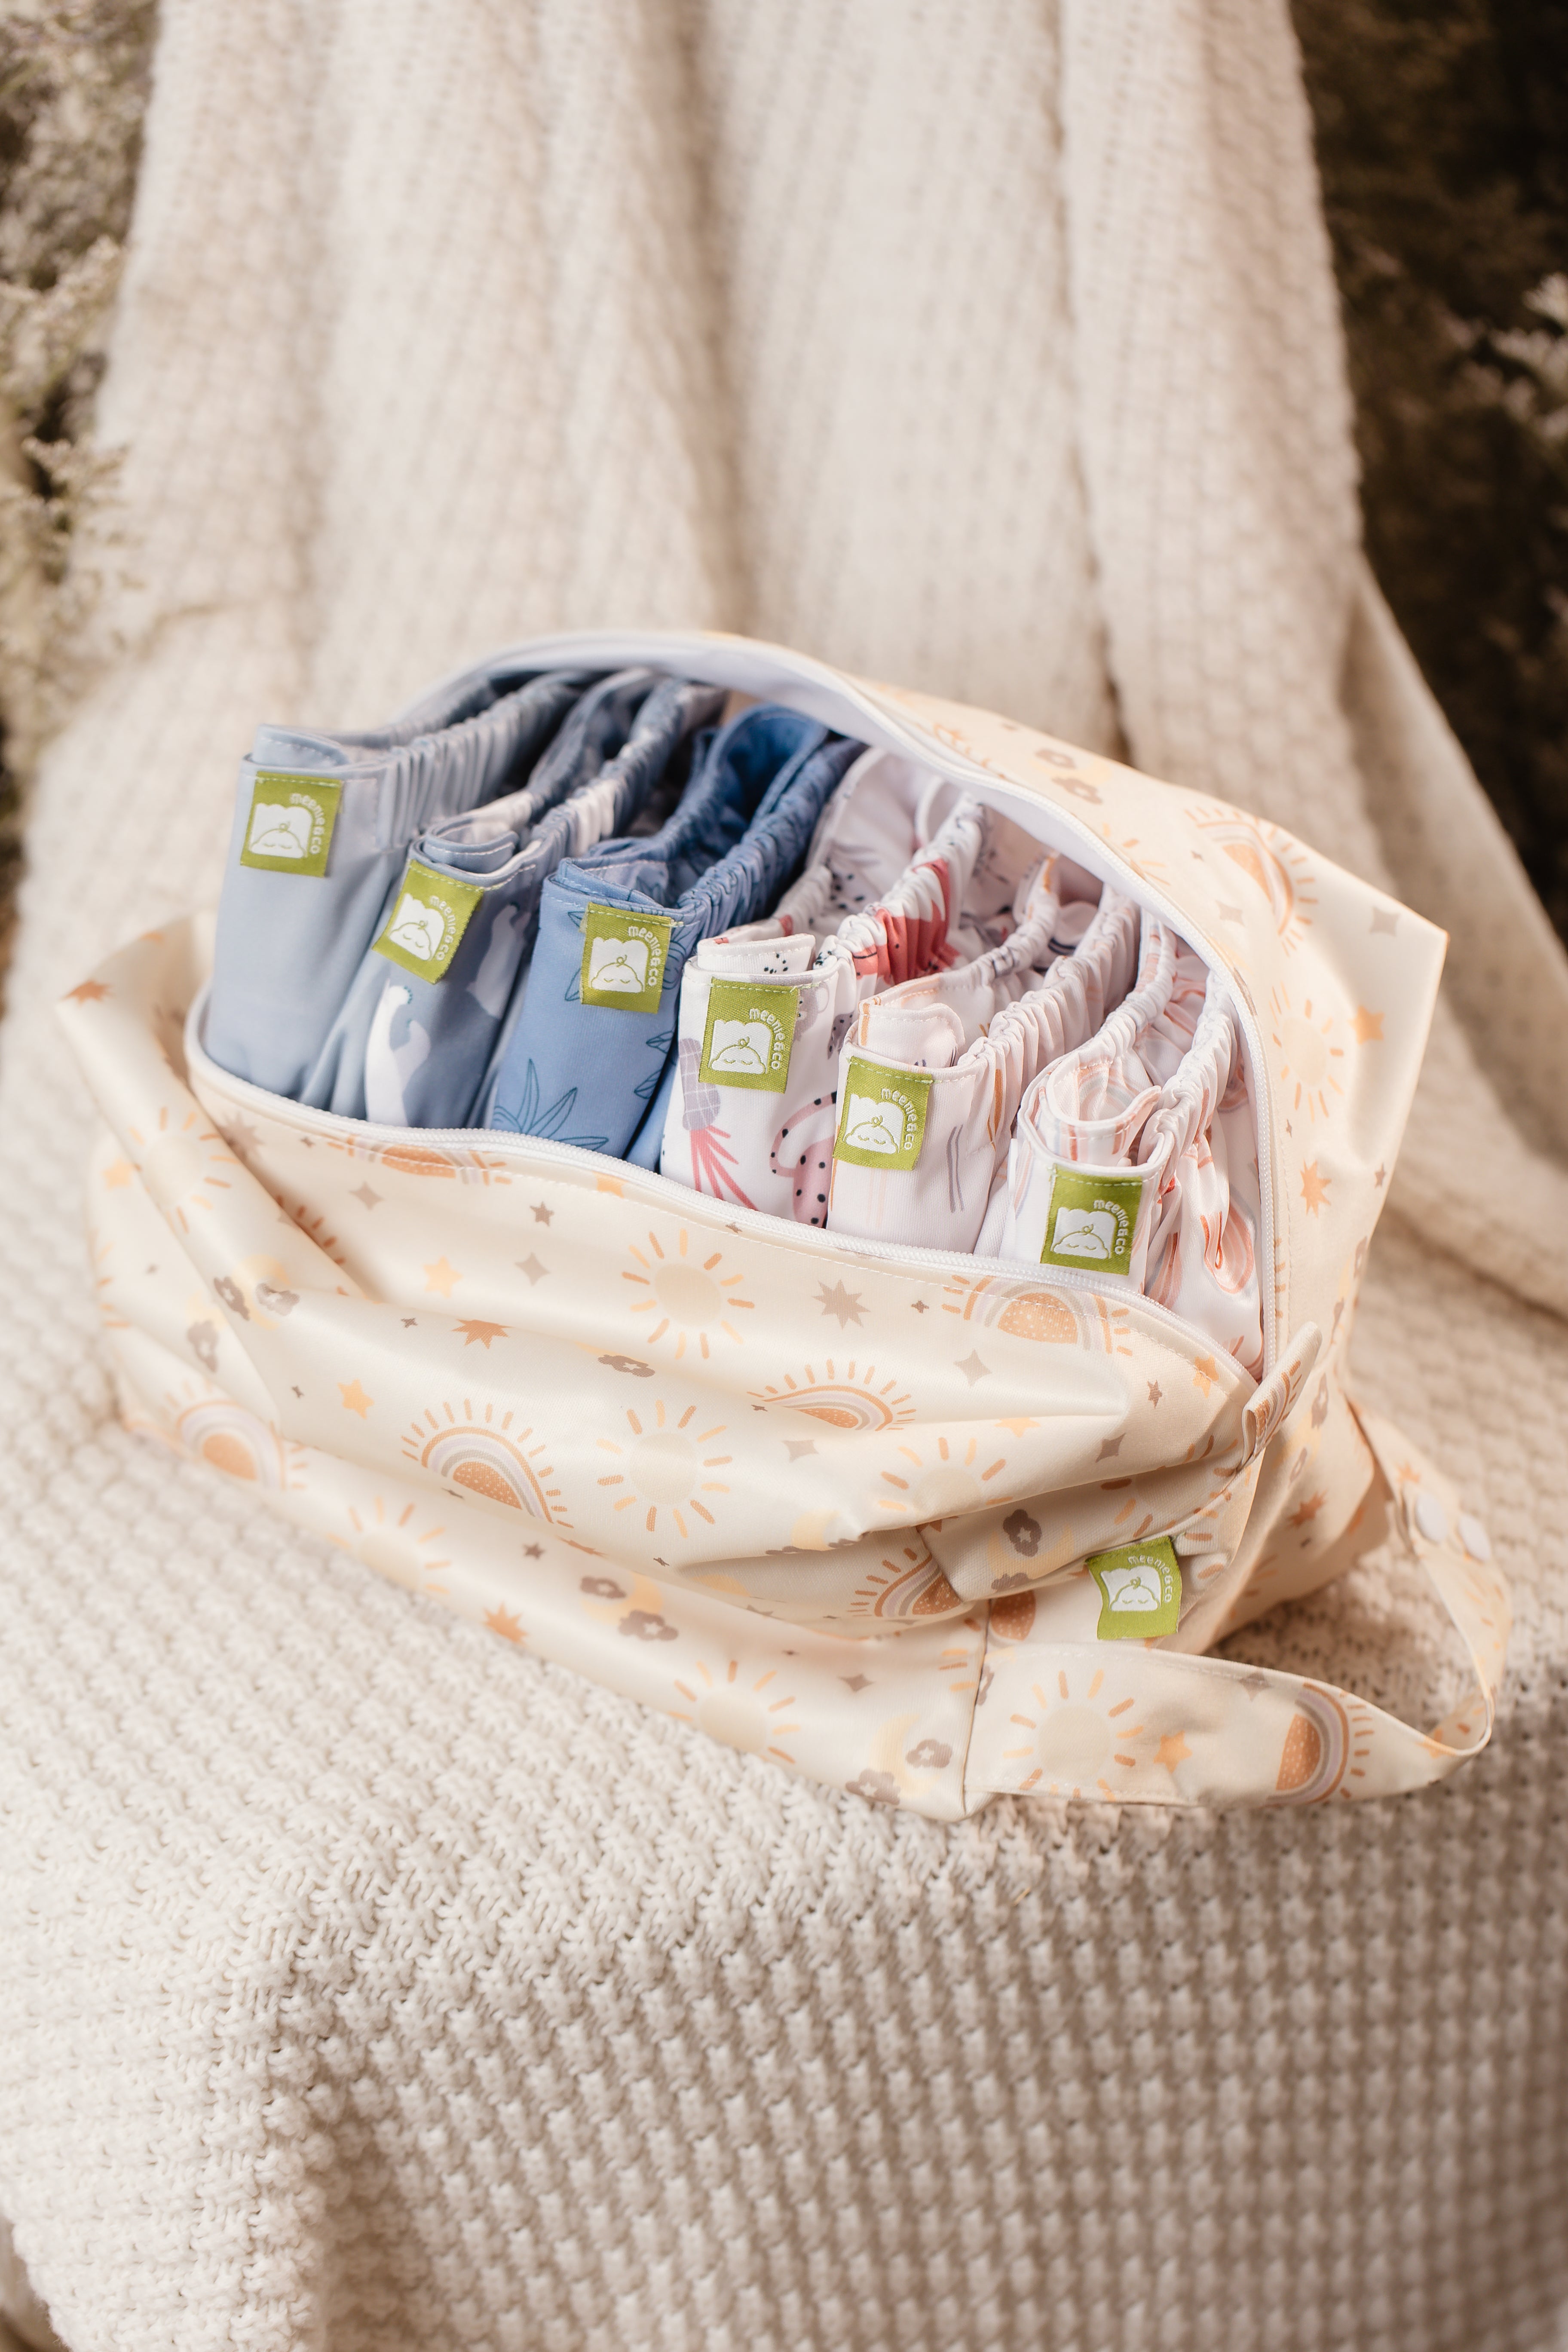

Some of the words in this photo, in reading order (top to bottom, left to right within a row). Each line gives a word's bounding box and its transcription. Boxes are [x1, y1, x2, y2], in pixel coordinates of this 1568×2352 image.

[430, 895, 457, 962] meenie&co
[628, 925, 661, 986] meenie&co
[749, 1007, 786, 1069] meenie&co
[881, 1087, 918, 1151] meenie&co
[1093, 1199, 1130, 1255] meenie&co
[1128, 1555, 1173, 1604] meenie&co
